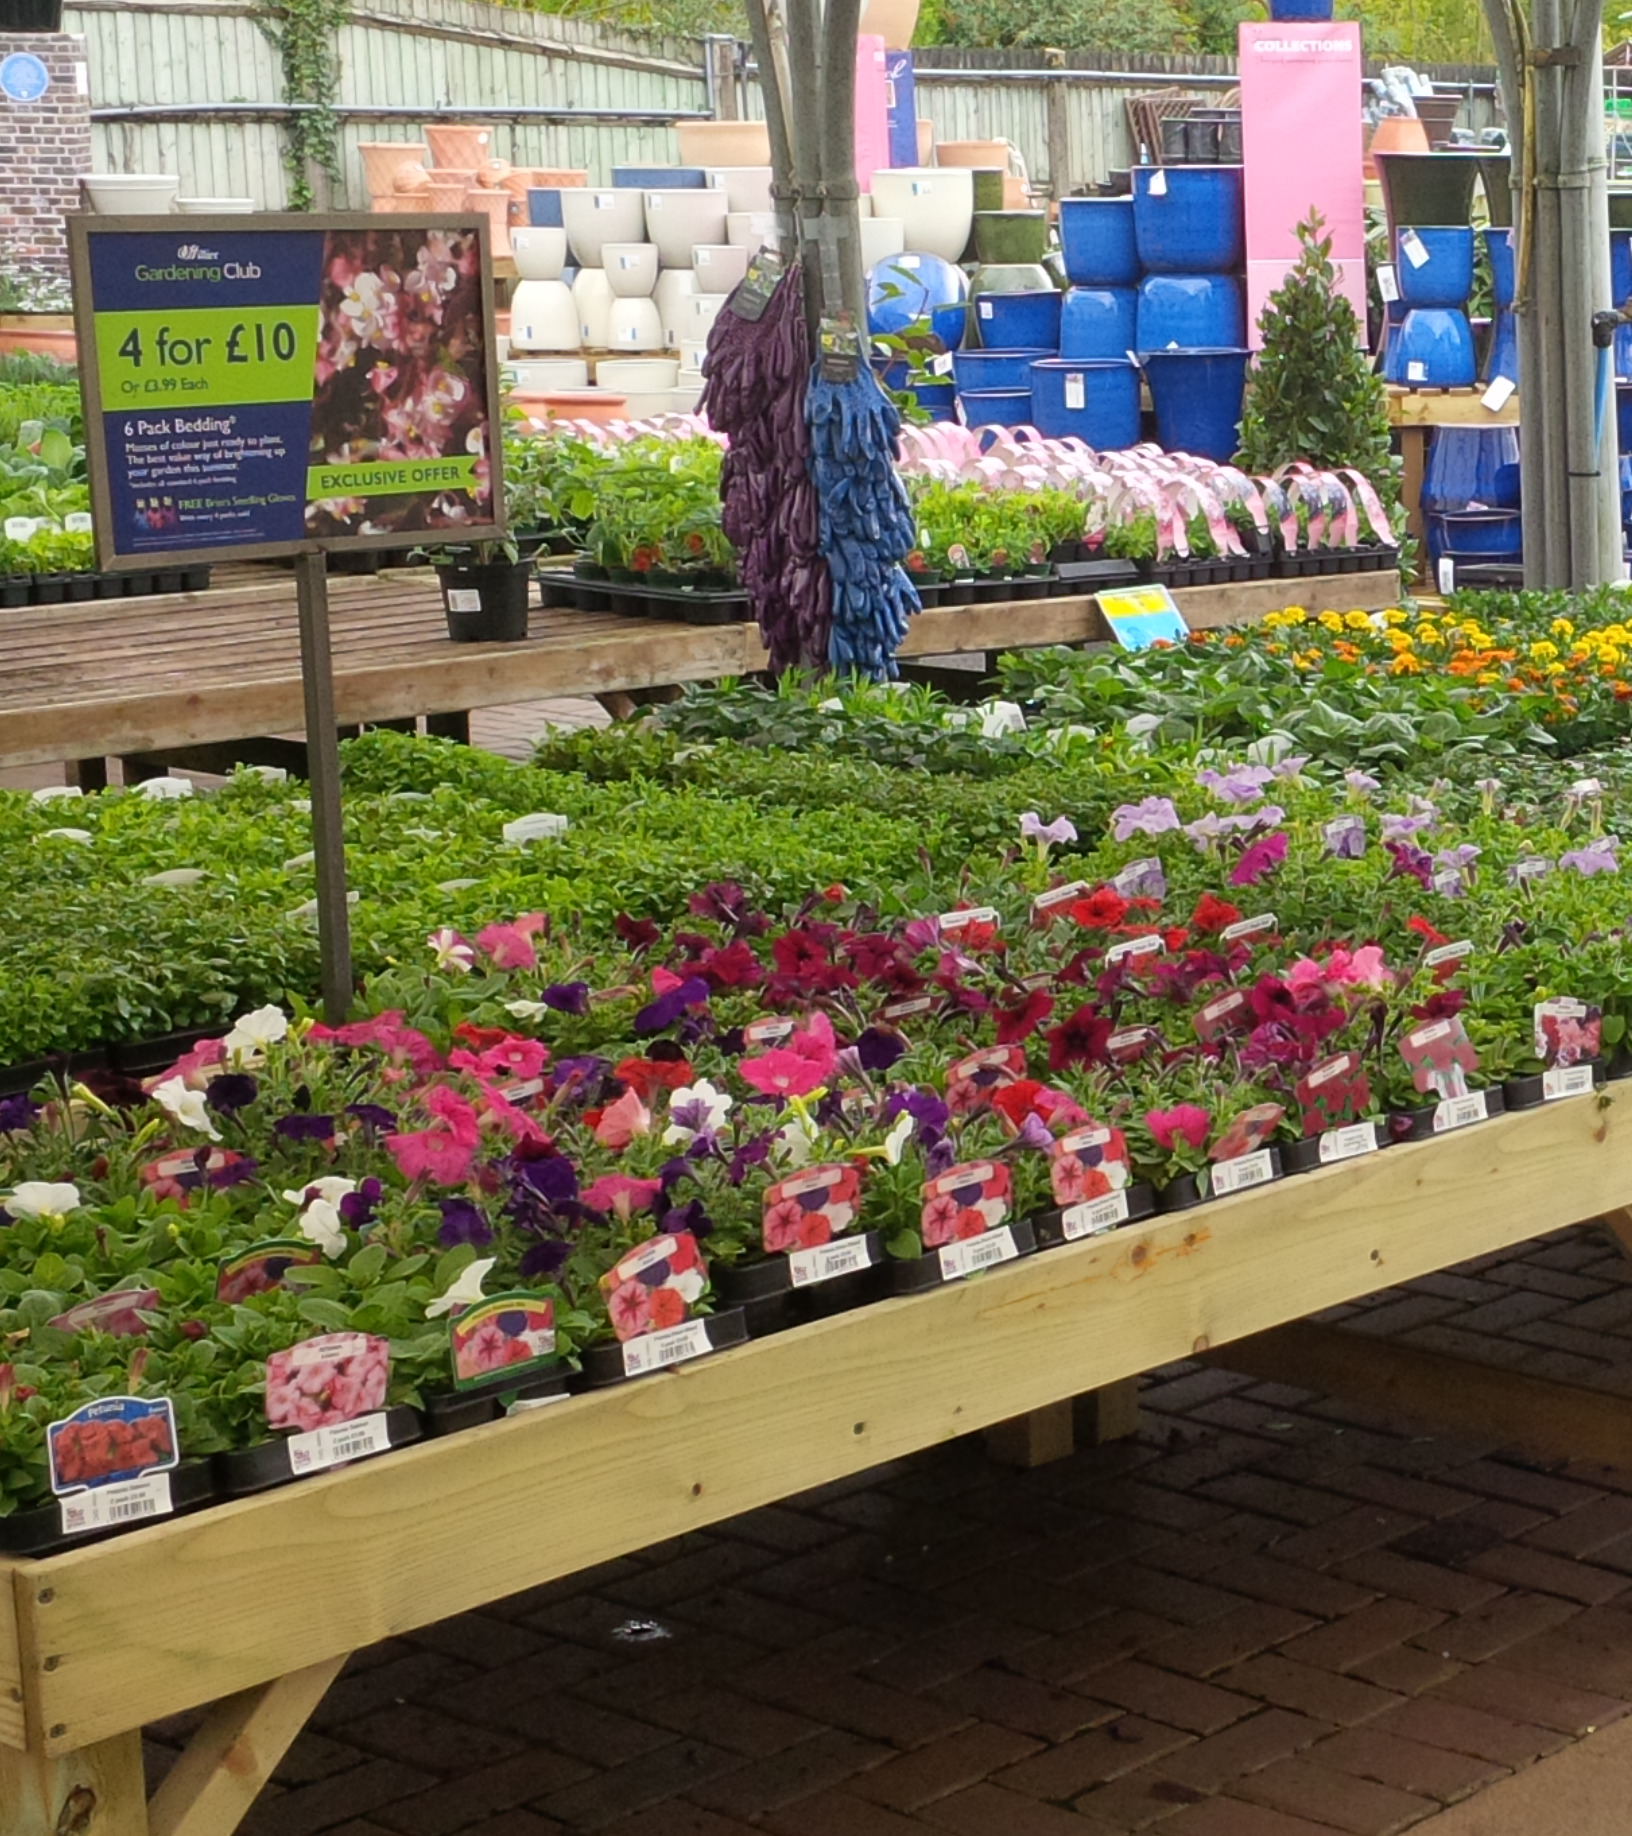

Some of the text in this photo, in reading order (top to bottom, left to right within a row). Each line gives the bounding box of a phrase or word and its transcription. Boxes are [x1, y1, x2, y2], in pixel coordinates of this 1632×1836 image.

[1254, 39, 1353, 53] COLLECTIONS
[135, 261, 262, 282] Gardening Club
[118, 322, 296, 368] 4 for £10
[121, 376, 209, 394] Or £3.99 Each
[124, 421, 134, 436] 6
[138, 418, 171, 435] Pack
[159, 441, 170, 451] of
[127, 455, 144, 465] The
[151, 465, 182, 478] garden
[320, 466, 461, 489] EXCLUSIVE OFFER
